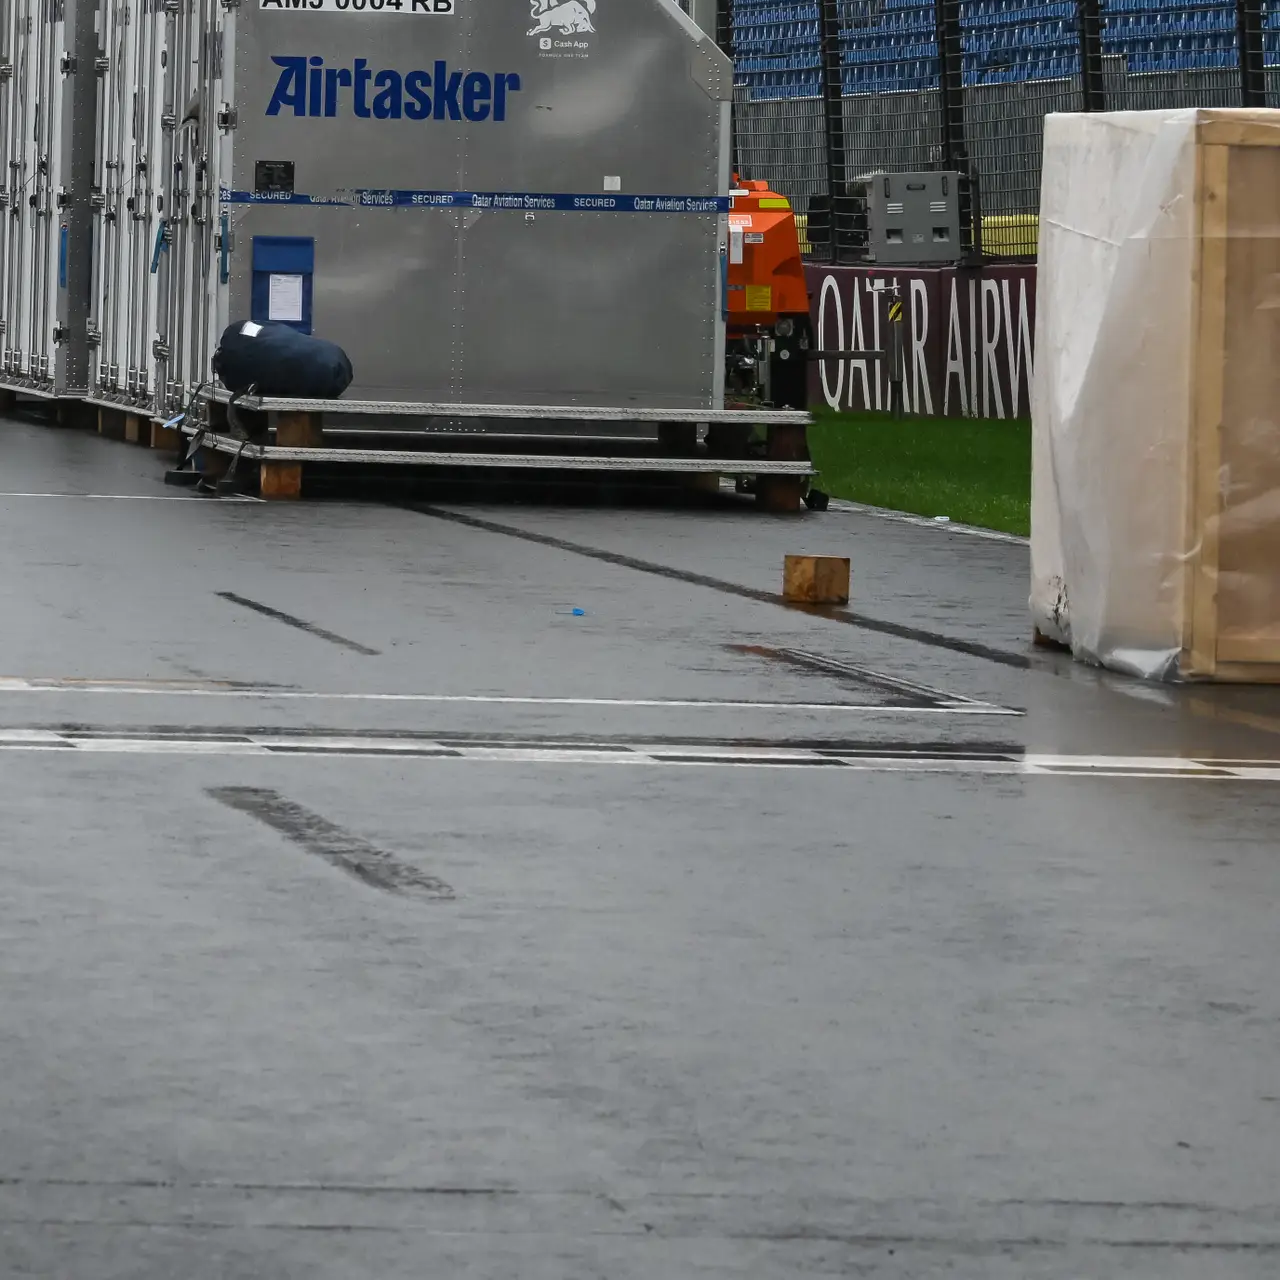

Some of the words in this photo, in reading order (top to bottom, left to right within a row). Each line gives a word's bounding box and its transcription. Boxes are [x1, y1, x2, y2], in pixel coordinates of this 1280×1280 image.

[573, 40, 589, 49] App
[265, 55, 521, 121] Airtasker
[249, 191, 291, 200] SECURED
[362, 191, 393, 205] Services
[411, 195, 454, 204] SECURED
[471, 193, 493, 208] Qatar
[493, 194, 523, 208] Aviation
[524, 194, 555, 208] Services
[574, 197, 616, 208] SECURED
[634, 197, 655, 210] Qatar
[655, 198, 685, 211] Aviation
[686, 198, 717, 211] Services
